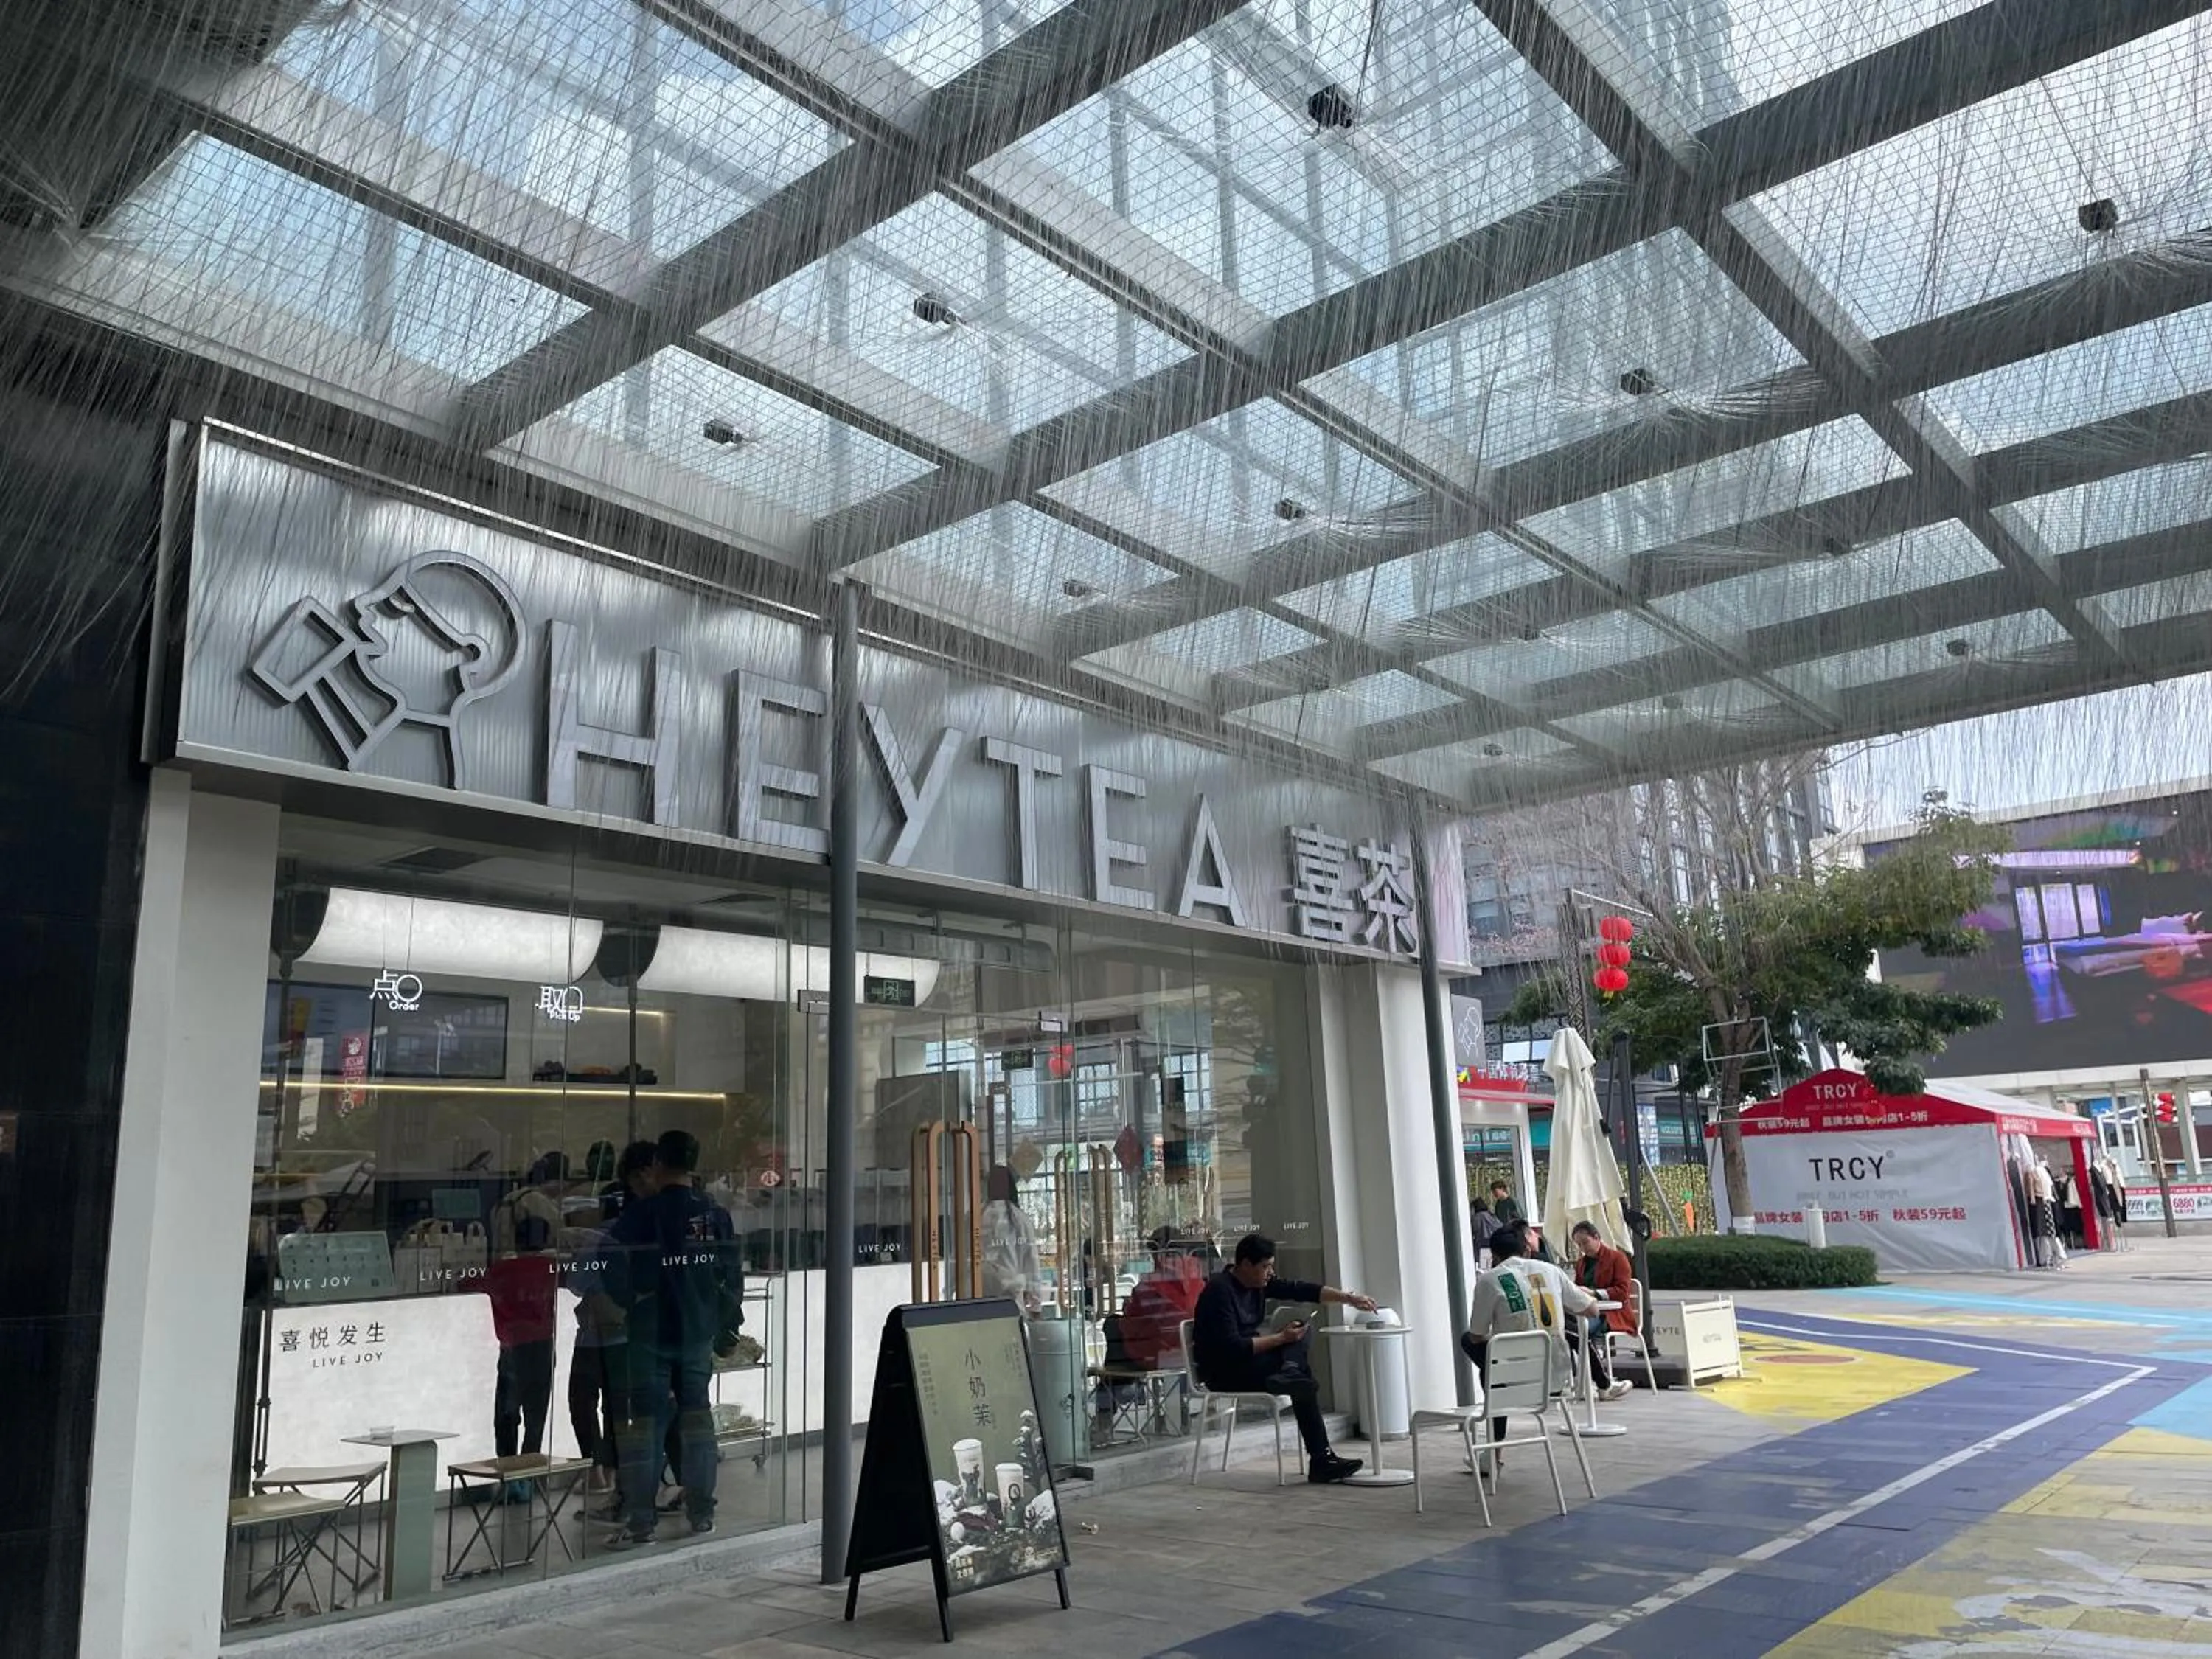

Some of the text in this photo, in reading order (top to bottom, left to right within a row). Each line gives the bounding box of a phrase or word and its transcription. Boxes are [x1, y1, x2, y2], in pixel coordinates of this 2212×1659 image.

[546, 618, 1246, 928] HEYTEA
[1287, 823, 1417, 954] 喜茶
[389, 1000, 419, 1011] Order
[1813, 1082, 1859, 1100] TRCY
[1809, 1156, 1884, 1182] TRCY
[1754, 1206, 1966, 1224] 品牌女装店1-5折 秋装59元起
[858, 1242, 901, 1253] LIVE JOY
[549, 1260, 608, 1273] LIVE JOY
[662, 1254, 714, 1266] LIVE JOY
[320, 1276, 351, 1289] JOY
[419, 1267, 487, 1281] LIVE JOY
[279, 1321, 386, 1352] 喜悦发生
[312, 1352, 383, 1368] LIVE JOY
[964, 1348, 992, 1427] 小奶茉
